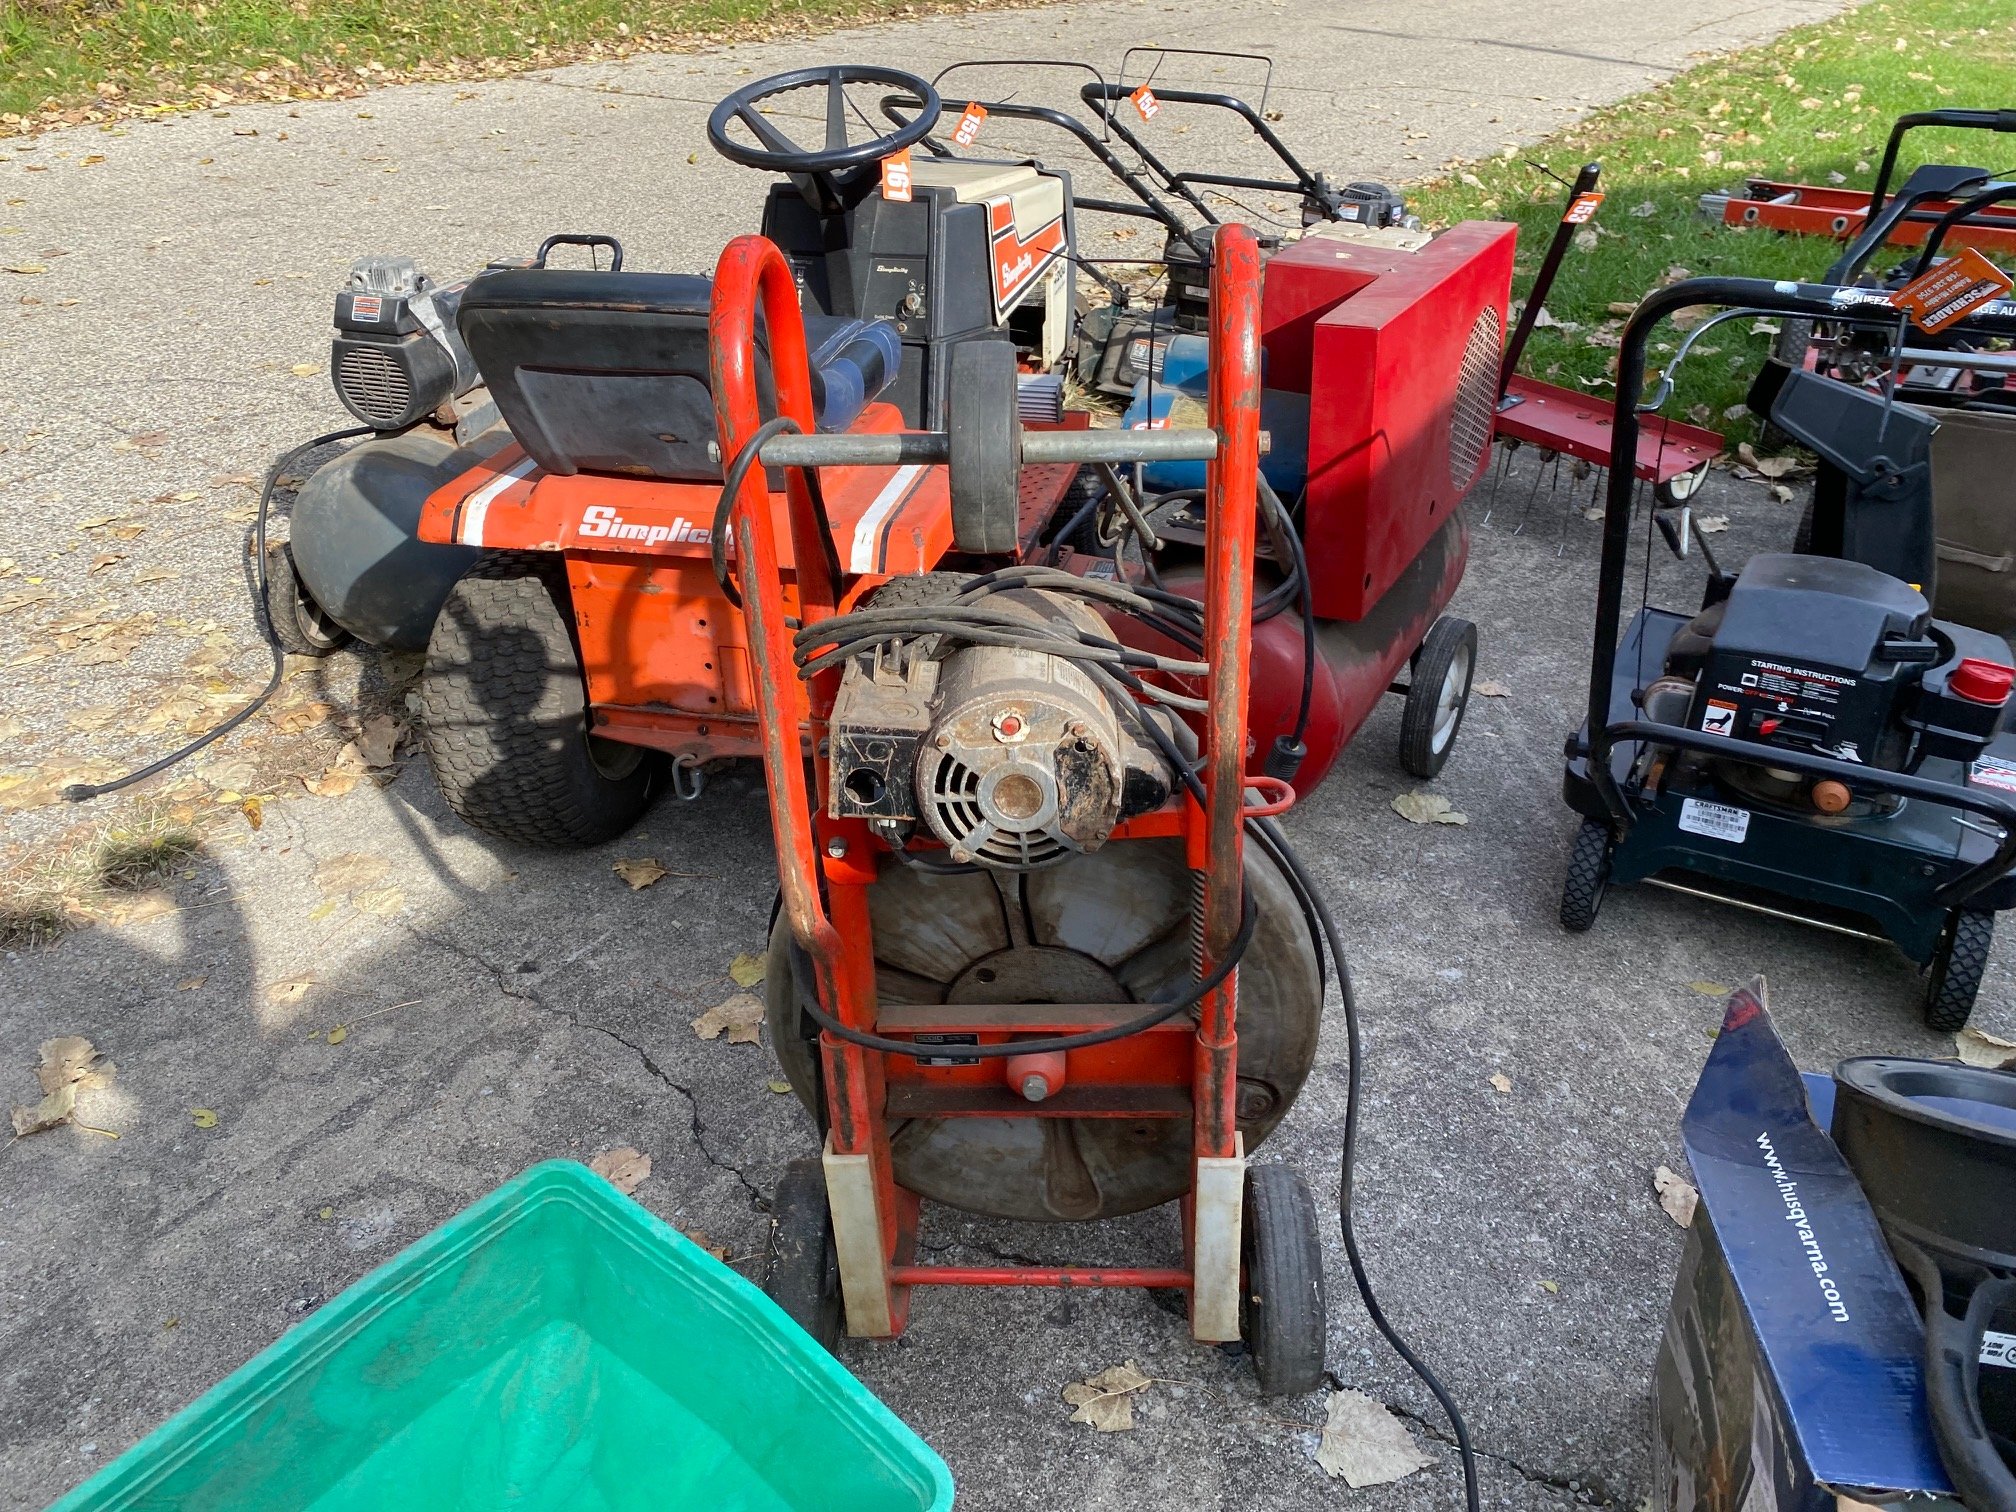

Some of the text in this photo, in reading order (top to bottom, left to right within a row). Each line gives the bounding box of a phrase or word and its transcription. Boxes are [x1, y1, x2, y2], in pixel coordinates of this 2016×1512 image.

[1137, 92, 1159, 119] 154
[955, 113, 981, 146] 155
[886, 161, 910, 199] 161
[1567, 199, 1598, 223] 153
[1921, 287, 1982, 329] SCHRADER
[1751, 660, 1792, 673] STARTING
[1793, 668, 1857, 686] INSTRUCTIONS
[1695, 801, 1739, 815] CRAFTSMAN
[1757, 1131, 1850, 1322] www.husqvarna.com
